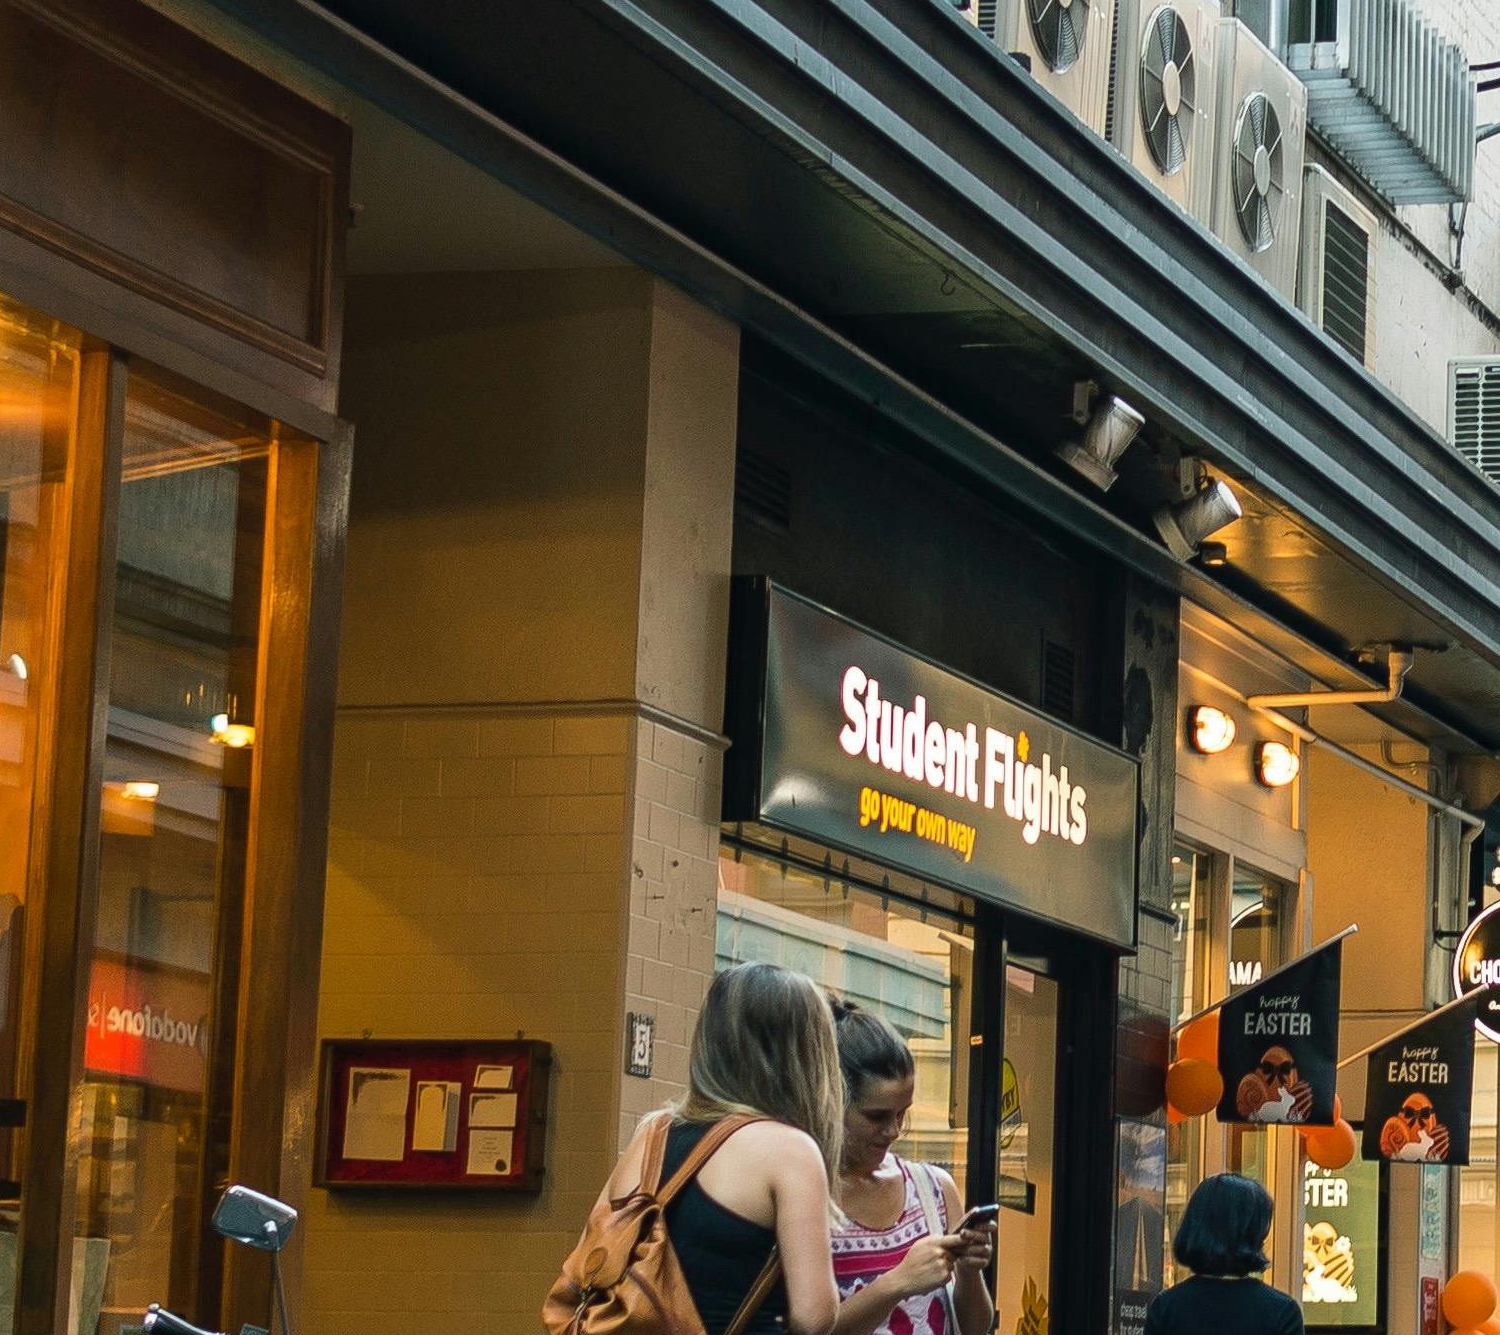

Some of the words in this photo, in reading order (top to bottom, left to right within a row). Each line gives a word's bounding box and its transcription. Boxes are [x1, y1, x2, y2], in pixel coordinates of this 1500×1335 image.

[837, 665, 981, 804] Student
[982, 725, 1089, 847] Flights
[859, 785, 881, 827] go
[880, 794, 916, 835] your
[916, 807, 947, 843] own
[946, 816, 977, 864] way
[1259, 994, 1301, 1009] happy
[1244, 1012, 1311, 1036] EASTER
[1402, 1046, 1440, 1060] happy
[1387, 1060, 1449, 1085] EASTER
